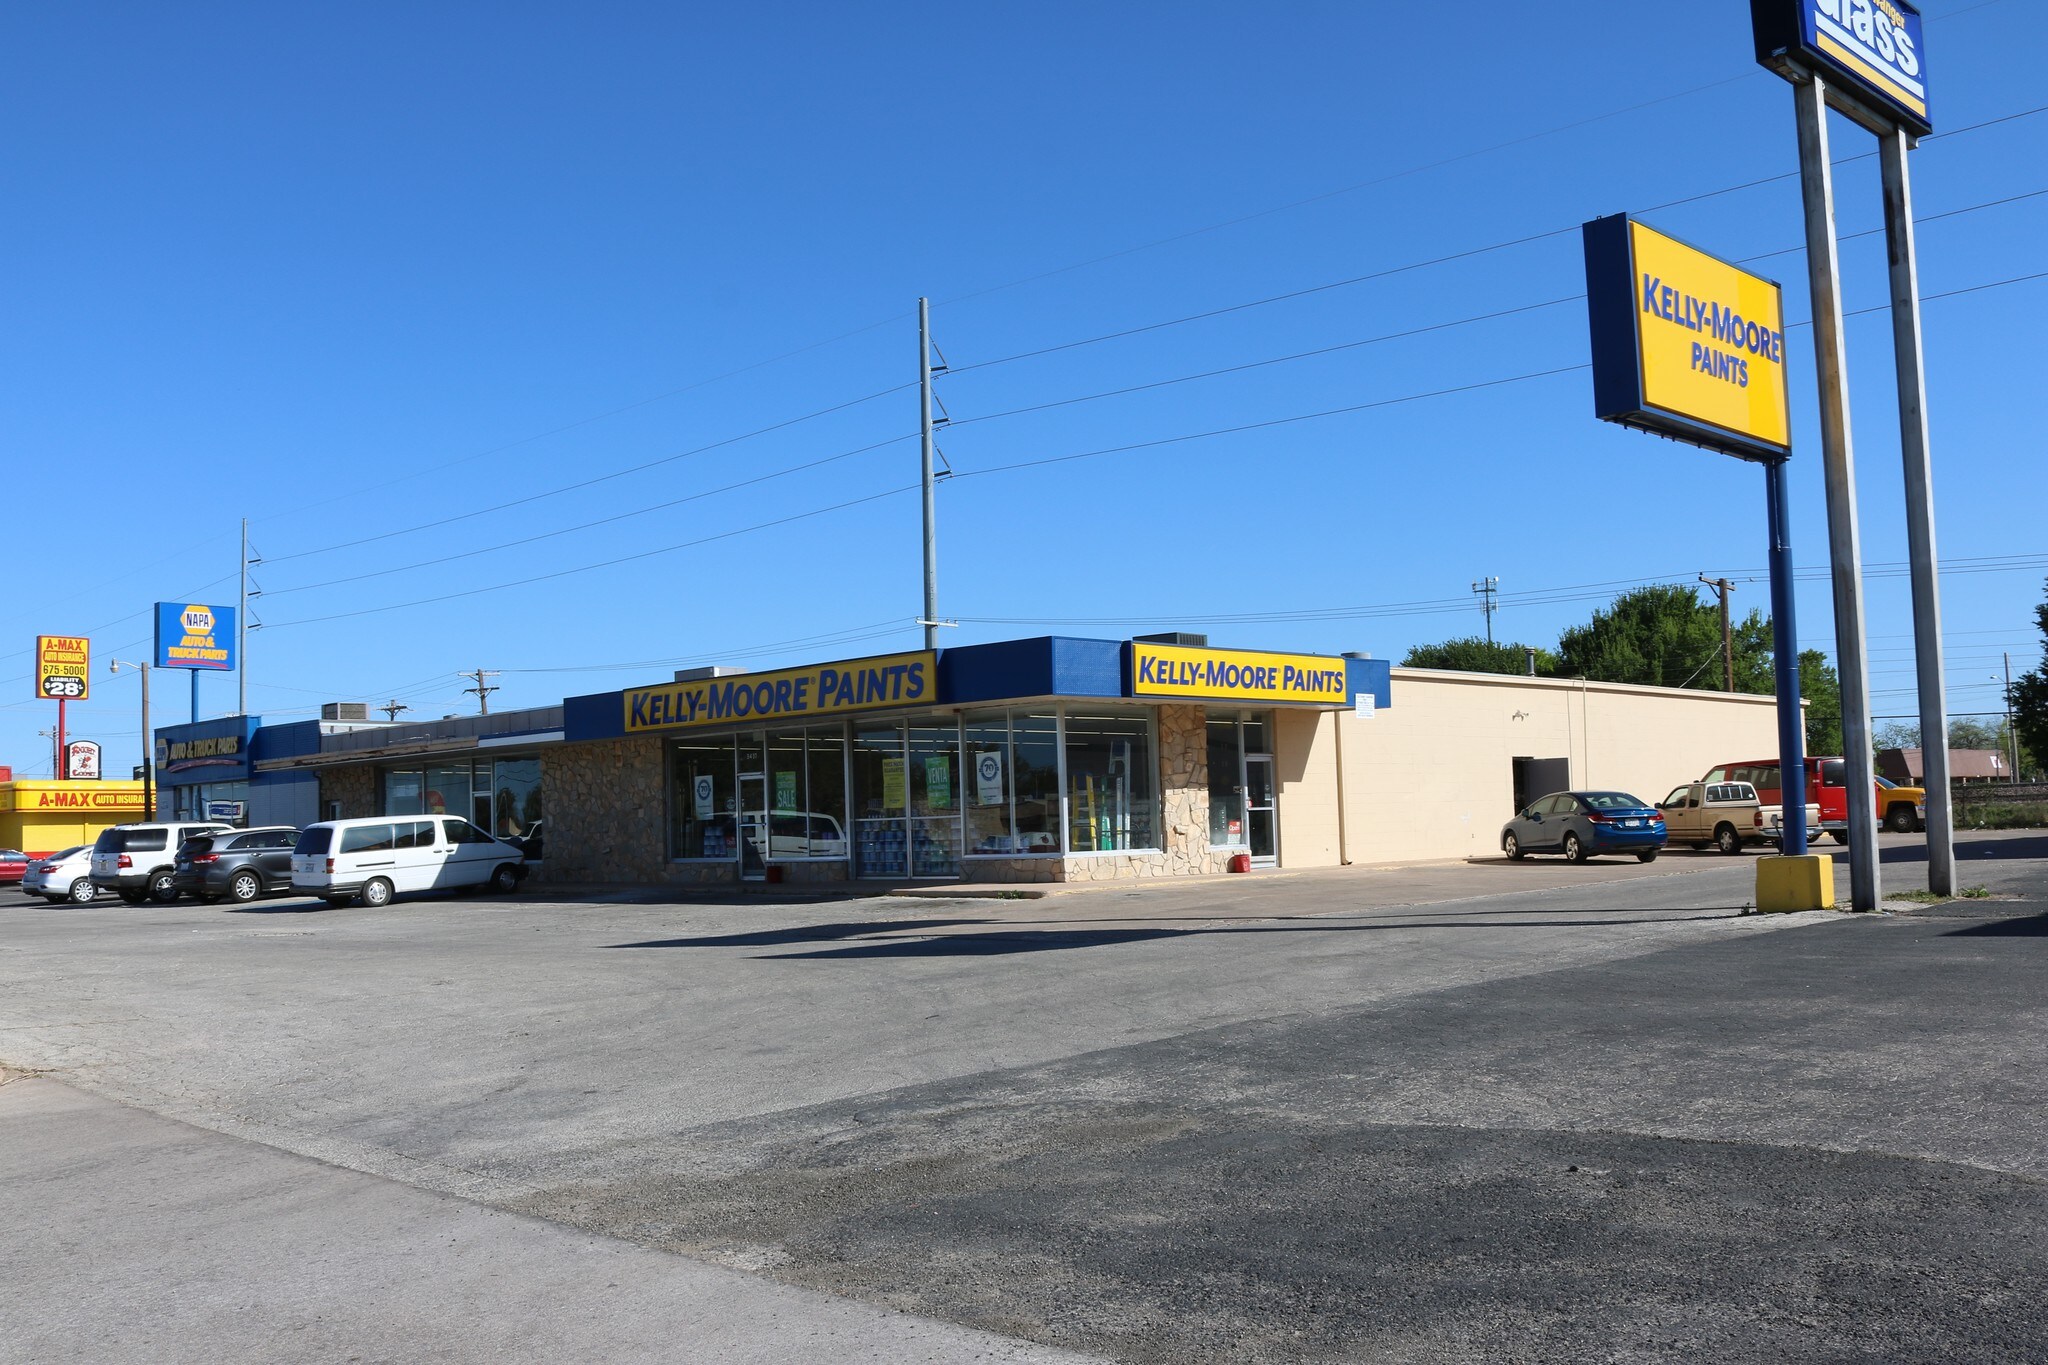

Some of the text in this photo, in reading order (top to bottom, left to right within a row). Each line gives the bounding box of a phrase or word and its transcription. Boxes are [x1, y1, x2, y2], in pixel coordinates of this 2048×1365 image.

[1643, 273, 1781, 364] KELLY-MOORE
[1691, 341, 1749, 388] PAINTS
[186, 613, 209, 628] NAPA
[46, 638, 83, 651] A-MAX
[180, 635, 216, 648] AUTO &
[44, 651, 58, 662] AUTO
[168, 646, 229, 661] TRUCK PARTS
[43, 664, 85, 676] 675-5000
[1139, 655, 1344, 694] KELLY-MOORE PAINTS
[631, 662, 925, 727] KELLY-MOORE PAINTS
[169, 742, 187, 760] AUTO
[186, 741, 194, 759] &
[194, 738, 218, 758] TRUCK
[217, 736, 239, 755] PARTS
[927, 766, 947, 784] VENTA
[38, 792, 91, 807] A-MAX
[95, 794, 115, 804] AUTO
[777, 790, 797, 808] SALE
